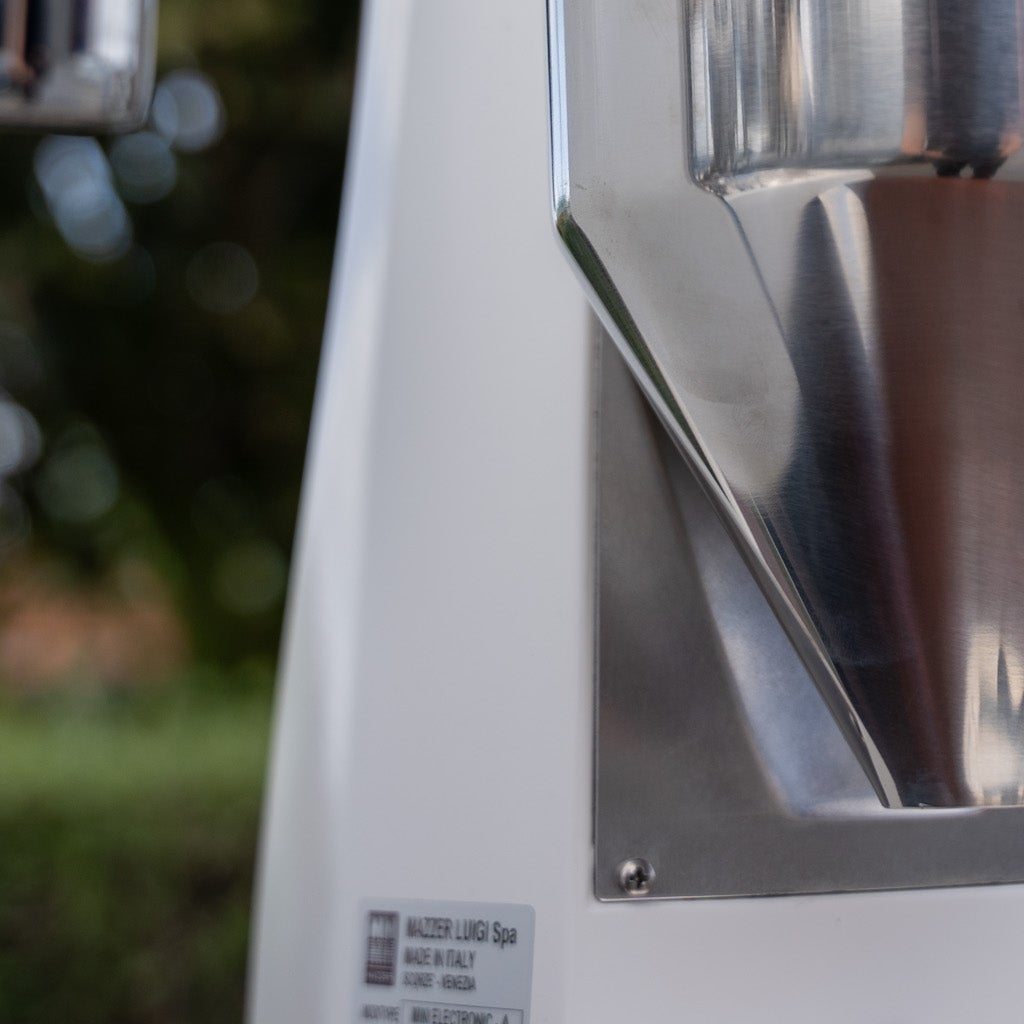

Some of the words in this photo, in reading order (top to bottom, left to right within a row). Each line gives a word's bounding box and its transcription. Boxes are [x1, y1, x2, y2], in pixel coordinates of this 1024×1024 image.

[406, 916, 453, 939] MAZZER
[455, 919, 488, 942] LUIGI
[492, 921, 517, 948] Spa
[404, 946, 431, 966] MADE
[434, 948, 444, 967] IN
[446, 948, 476, 969] ITALY
